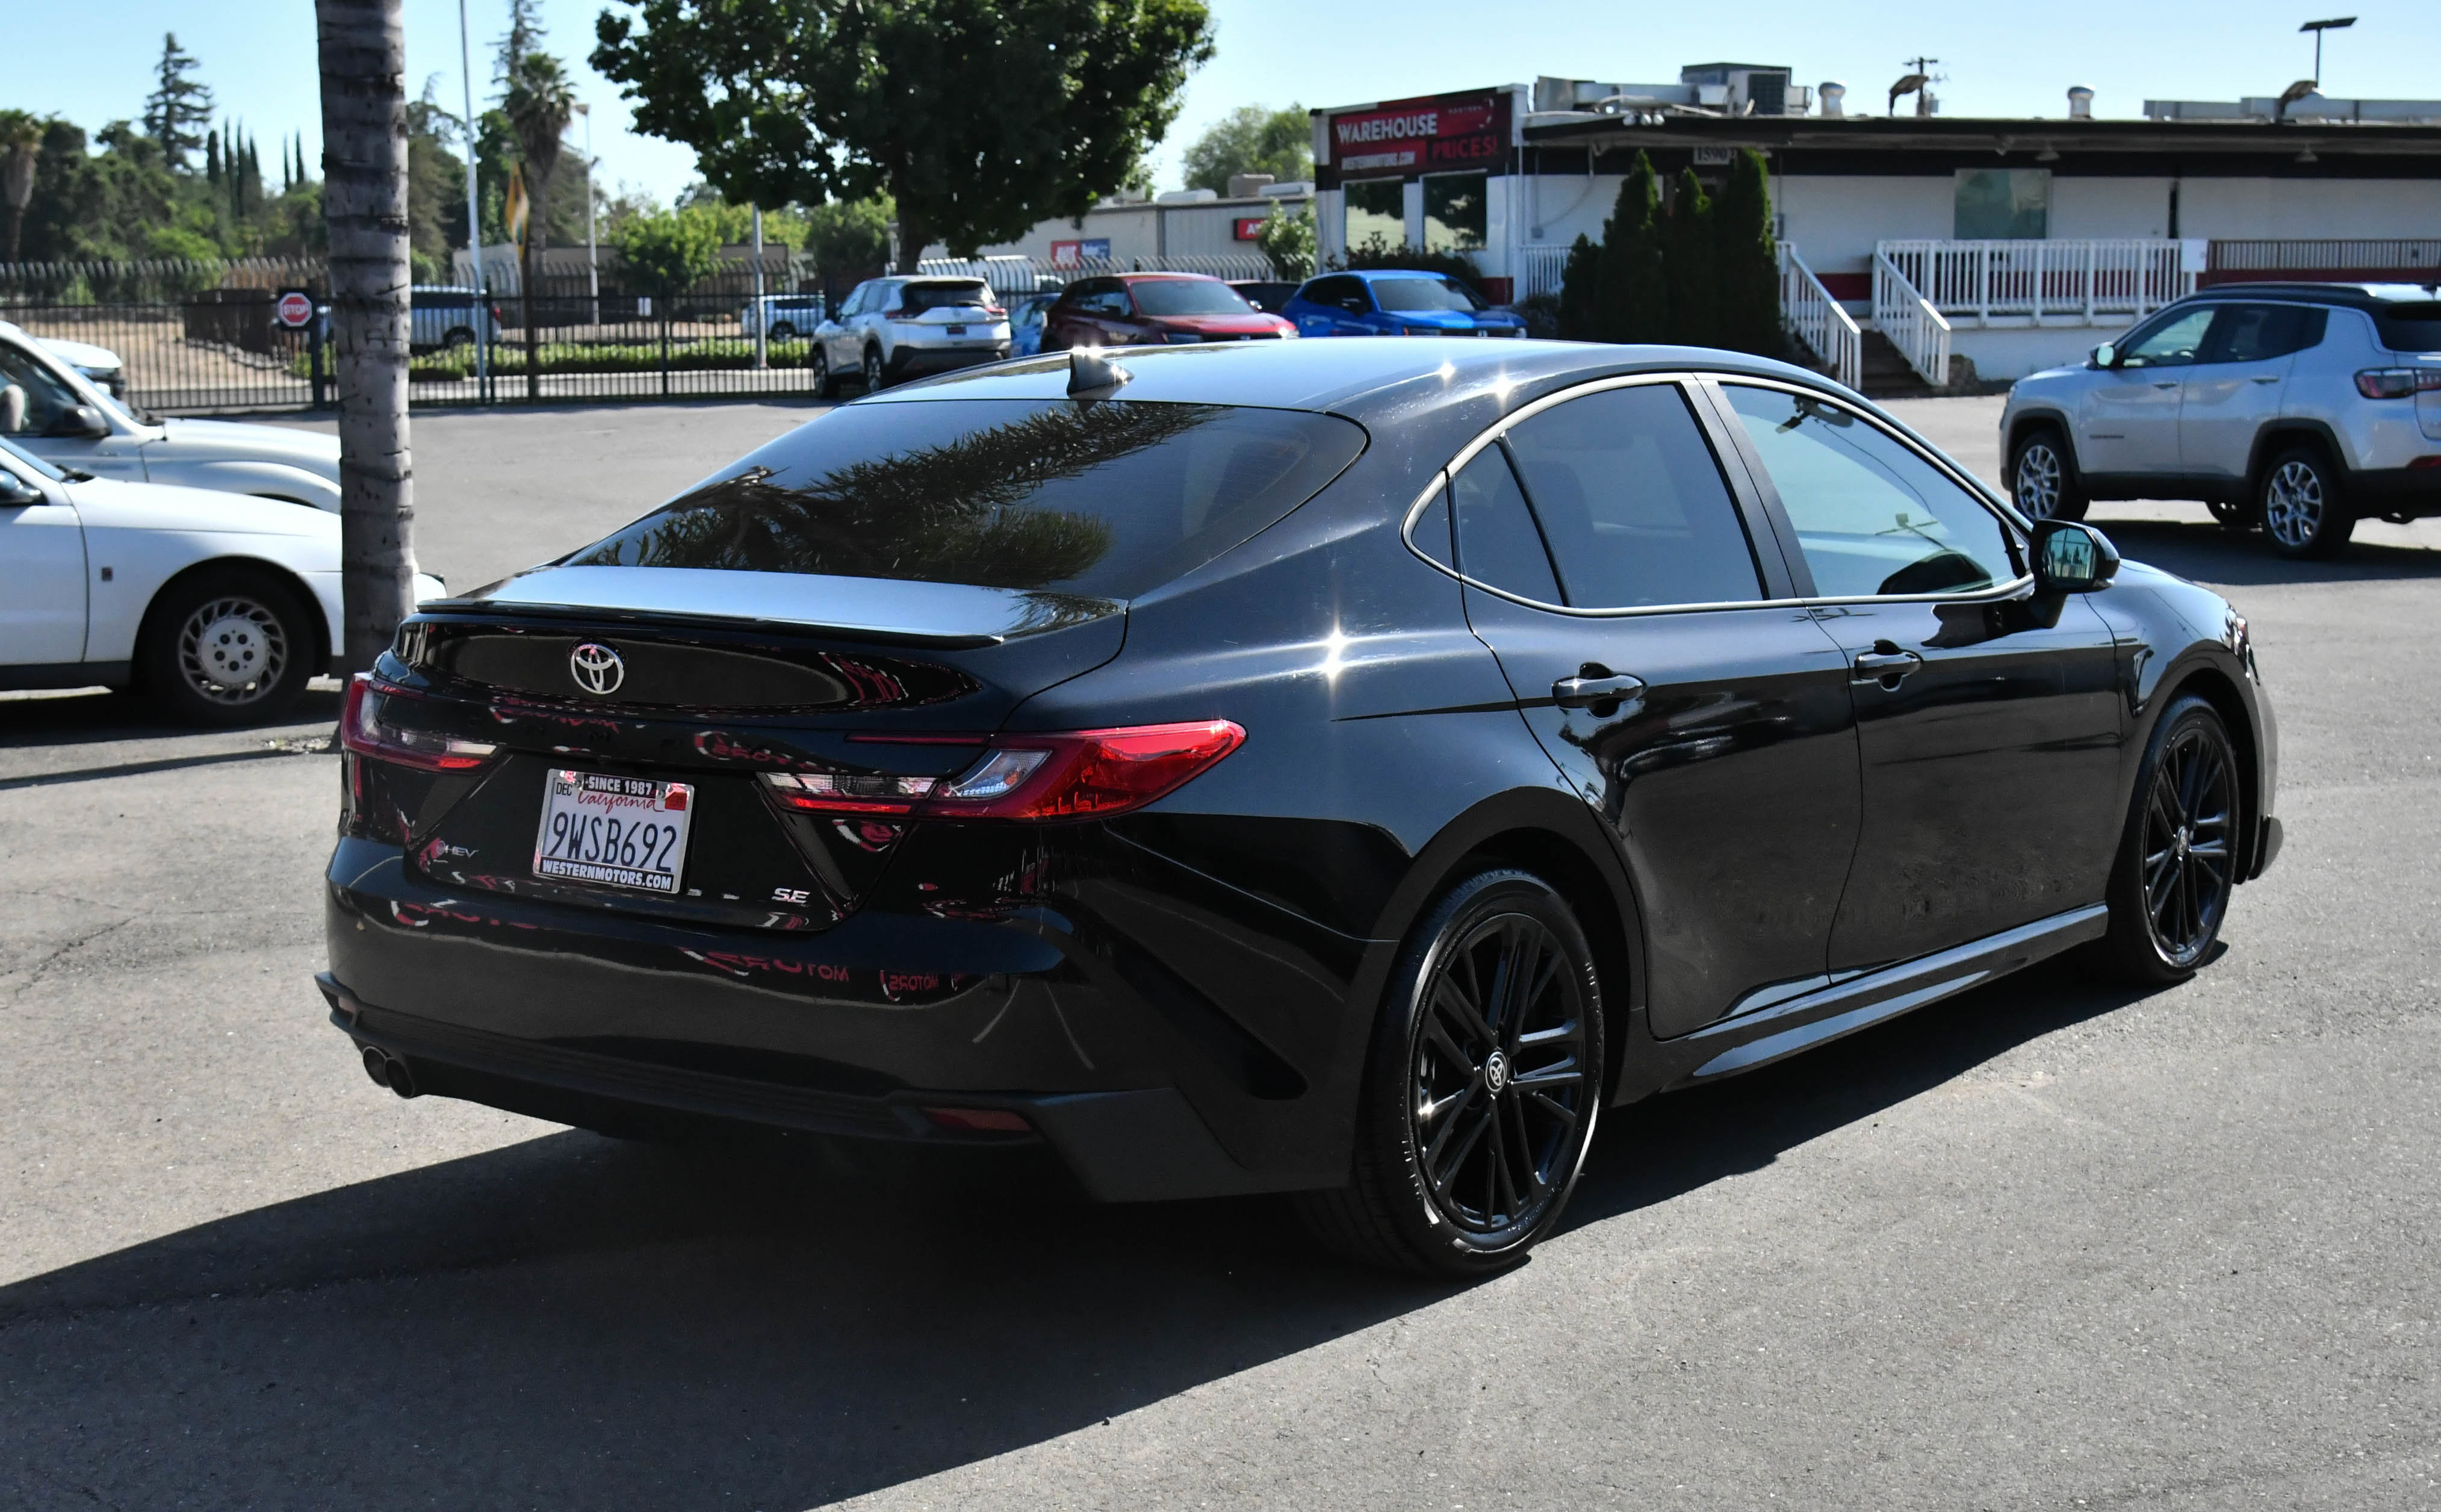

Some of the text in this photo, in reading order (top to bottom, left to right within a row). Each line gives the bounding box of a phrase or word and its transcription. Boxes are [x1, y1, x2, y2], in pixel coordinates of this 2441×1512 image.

[1337, 113, 1438, 144] WAREHOUSE
[284, 304, 309, 315] STOP
[556, 782, 572, 796] DEC
[588, 776, 652, 795] SINCE 1987
[578, 792, 665, 814] California
[548, 812, 677, 872] 9WSB692
[542, 860, 672, 890] WESTERNMOTORS.COM
[771, 888, 811, 903] SE
